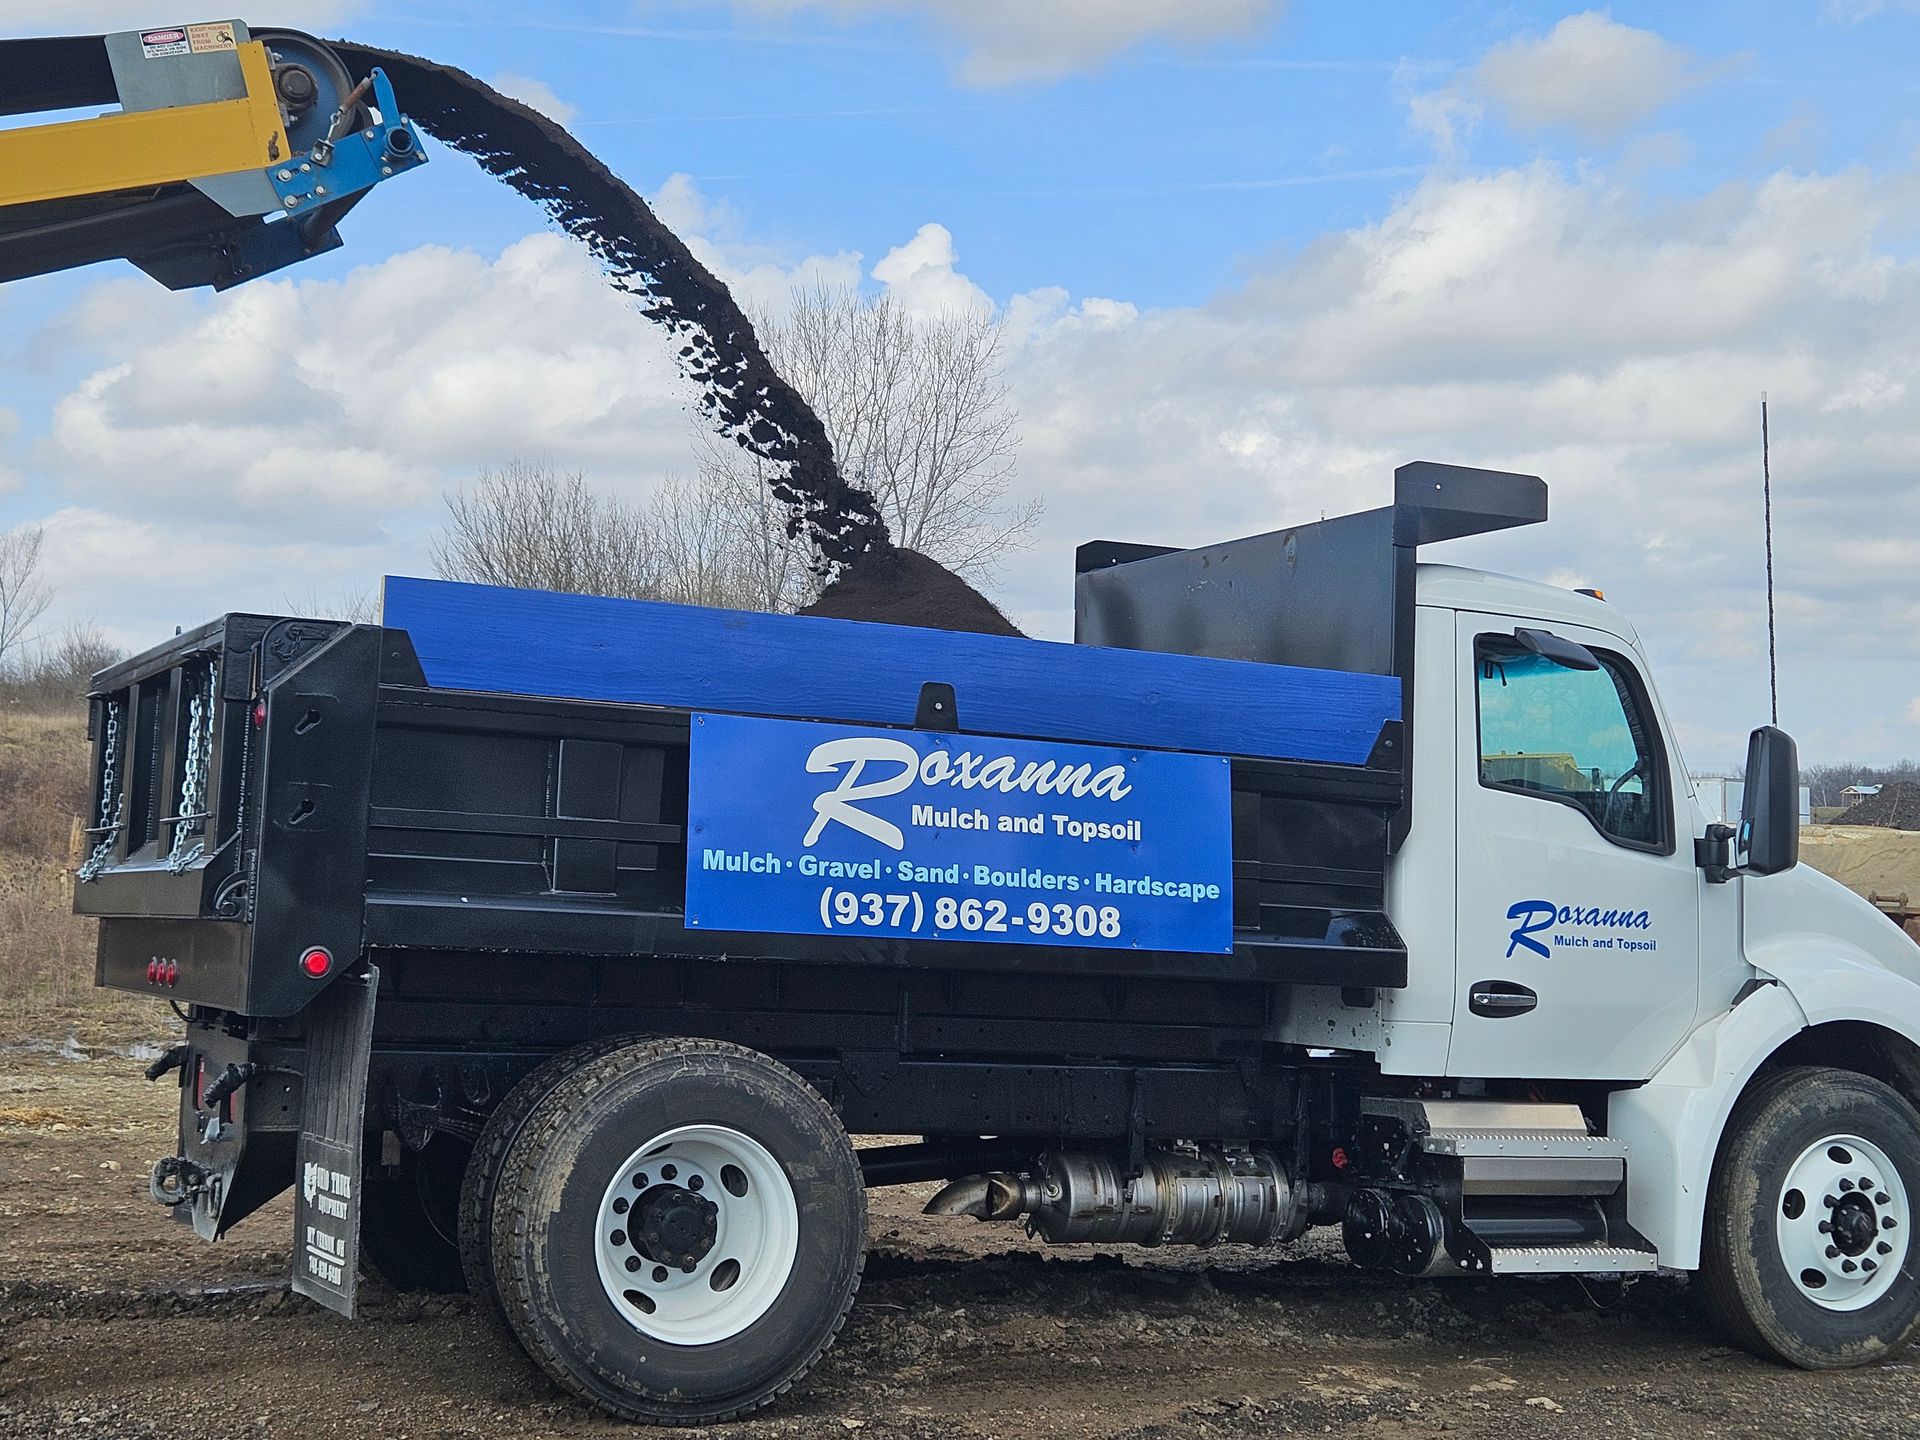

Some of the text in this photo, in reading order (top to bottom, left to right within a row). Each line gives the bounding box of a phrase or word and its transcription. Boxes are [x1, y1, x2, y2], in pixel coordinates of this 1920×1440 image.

[147, 32, 180, 42] DANGER
[194, 43, 232, 51] MACHINERY
[803, 737, 1133, 851] Roxanna
[911, 804, 1141, 843] Mulch and Topsoil
[703, 848, 1220, 903] Mulch Gravel Sand Boulders Hardscape
[820, 886, 1121, 938] (937) 862-9308
[1505, 899, 1652, 959] Roxanna
[1554, 934, 1657, 953] Mulch and Topsoil
